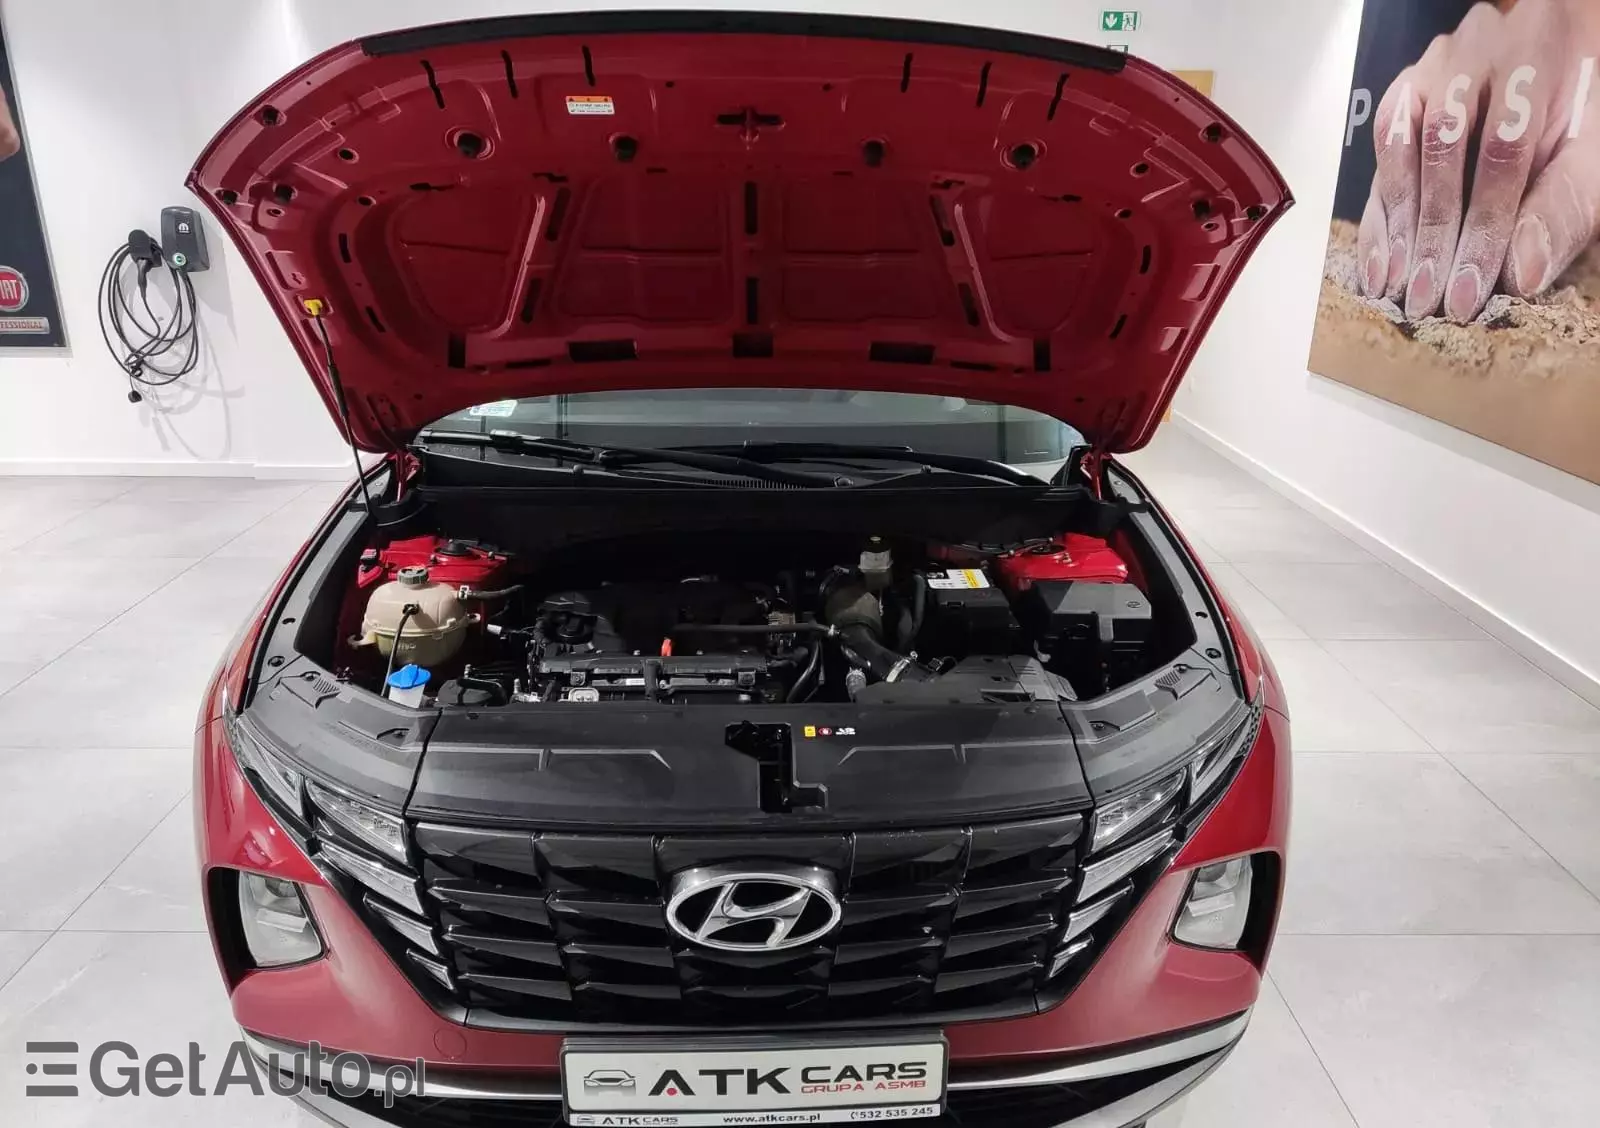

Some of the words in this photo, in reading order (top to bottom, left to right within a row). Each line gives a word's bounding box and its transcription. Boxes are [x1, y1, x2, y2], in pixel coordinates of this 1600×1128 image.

[648, 1066, 791, 1097] ATK
[801, 1061, 927, 1084] CARS
[801, 1083, 865, 1094] GRUPA
[875, 1080, 926, 1090] ASMB
[723, 1113, 821, 1123] www.atkcars.pl
[860, 1110, 882, 1119] 532
[885, 1109, 908, 1117] 535
[911, 1107, 934, 1116] 245
[602, 1117, 640, 1125] ATK
